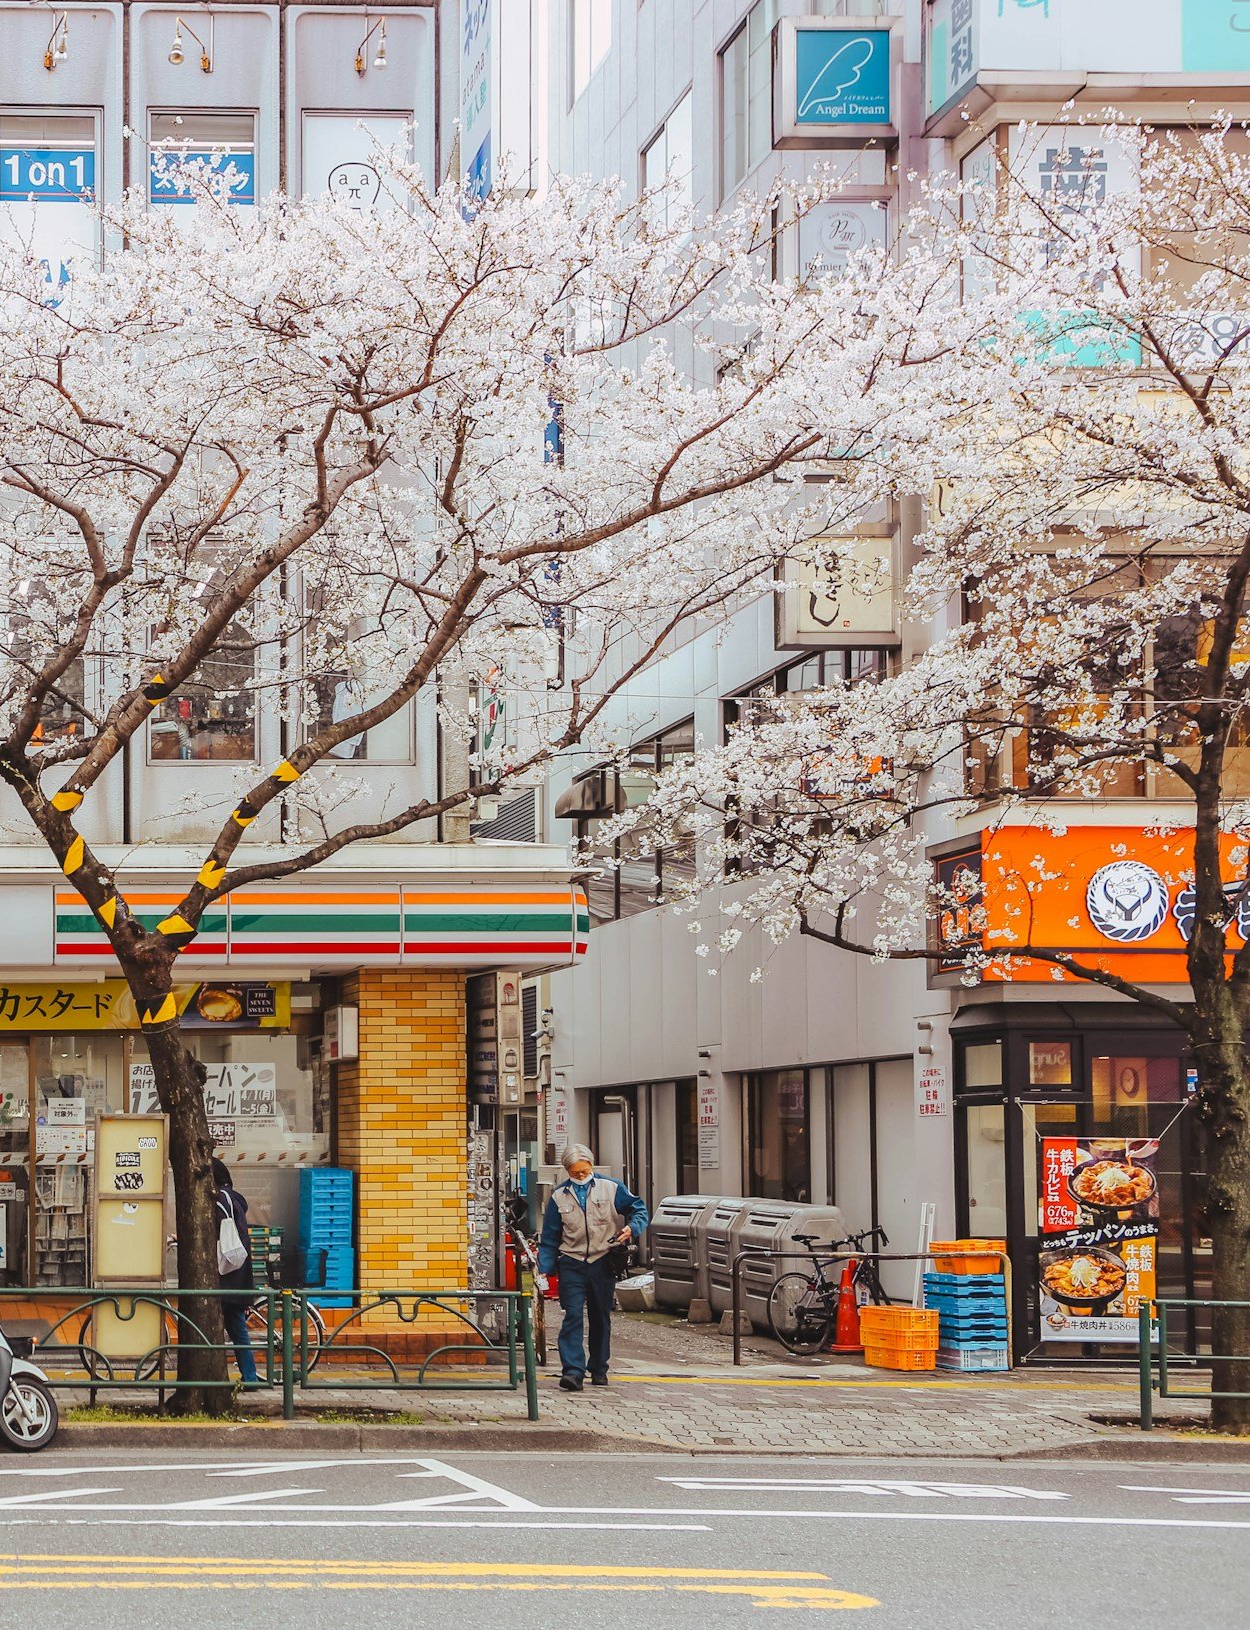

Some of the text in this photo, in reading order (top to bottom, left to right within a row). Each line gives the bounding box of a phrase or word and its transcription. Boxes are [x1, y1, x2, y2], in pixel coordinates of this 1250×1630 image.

[816, 103, 885, 117] Angel Dream
[132, 1065, 156, 1077] お店
[205, 1090, 238, 1115] セール
[1059, 1148, 1075, 1177] 鉄板
[1047, 1205, 1075, 1218] 676円
[1139, 1244, 1153, 1272] 鉄板
[1070, 1320, 1107, 1331] 牛焼肉丼
